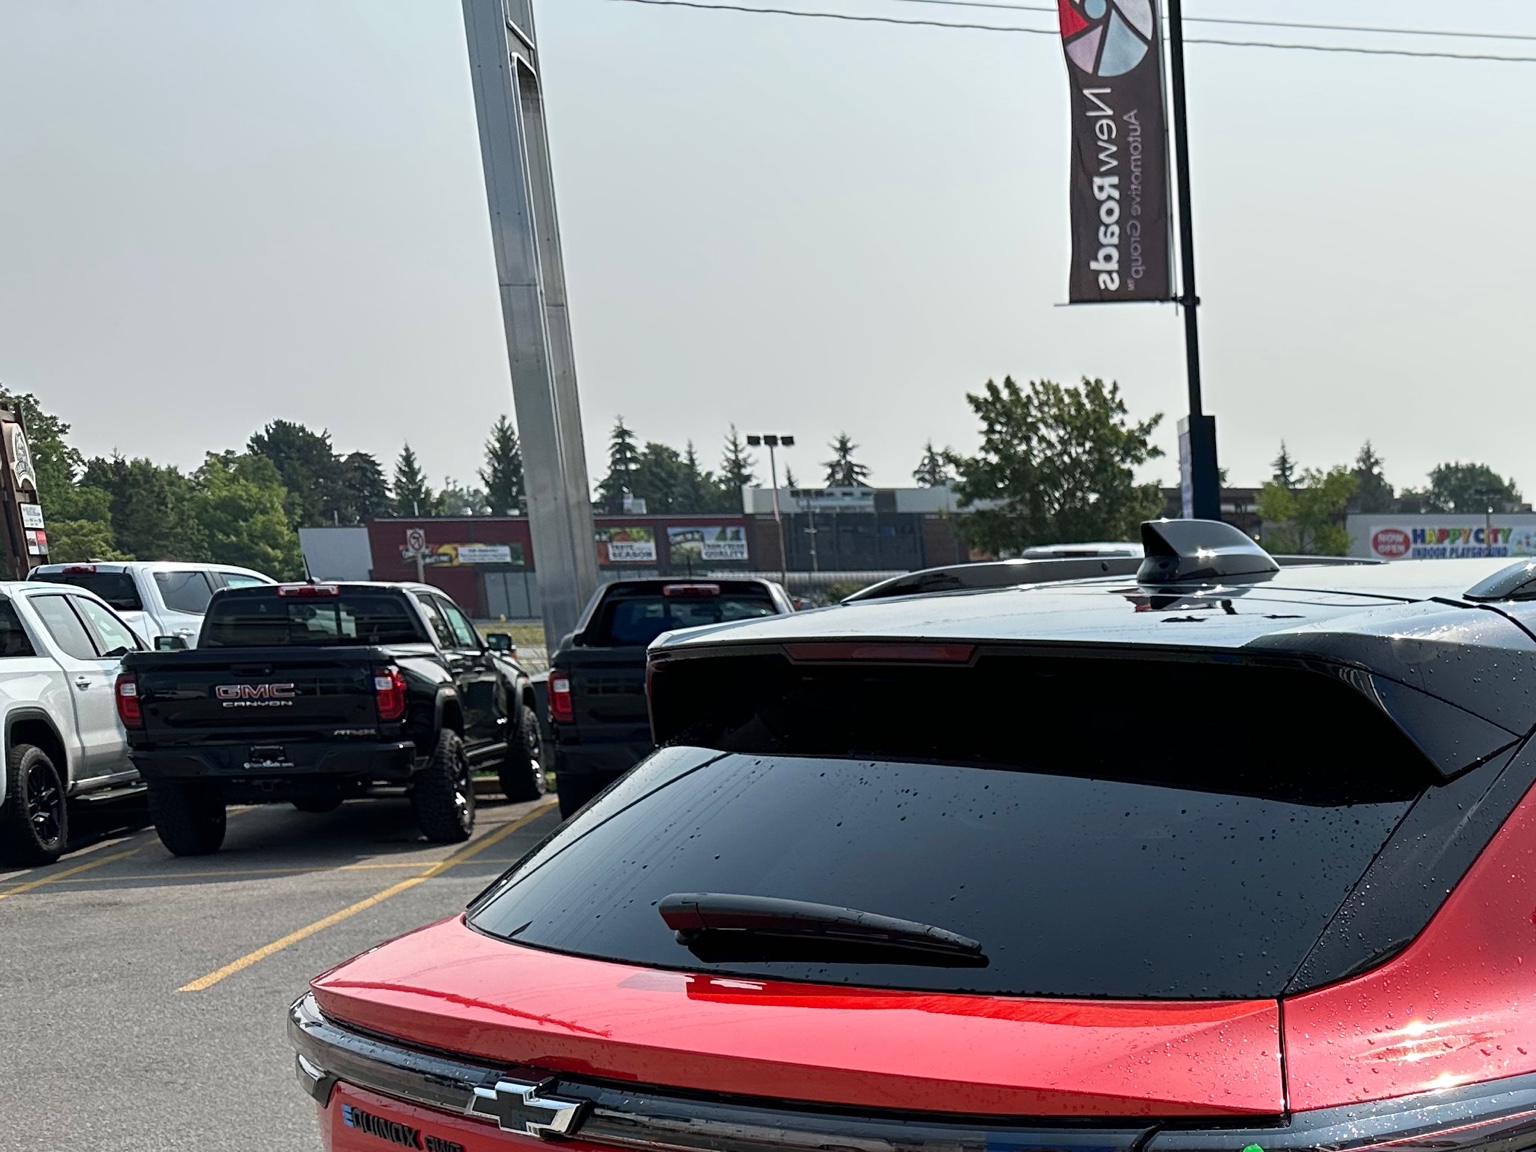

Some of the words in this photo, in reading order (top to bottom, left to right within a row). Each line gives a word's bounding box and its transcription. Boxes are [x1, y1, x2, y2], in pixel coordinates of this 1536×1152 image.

[1377, 534, 1404, 543] NOW
[1412, 528, 1472, 544] HAPPY
[1474, 528, 1512, 544] CITY
[1377, 544, 1405, 554] OPEN
[216, 683, 295, 699] GMC
[341, 1103, 423, 1151] EQUINOX
